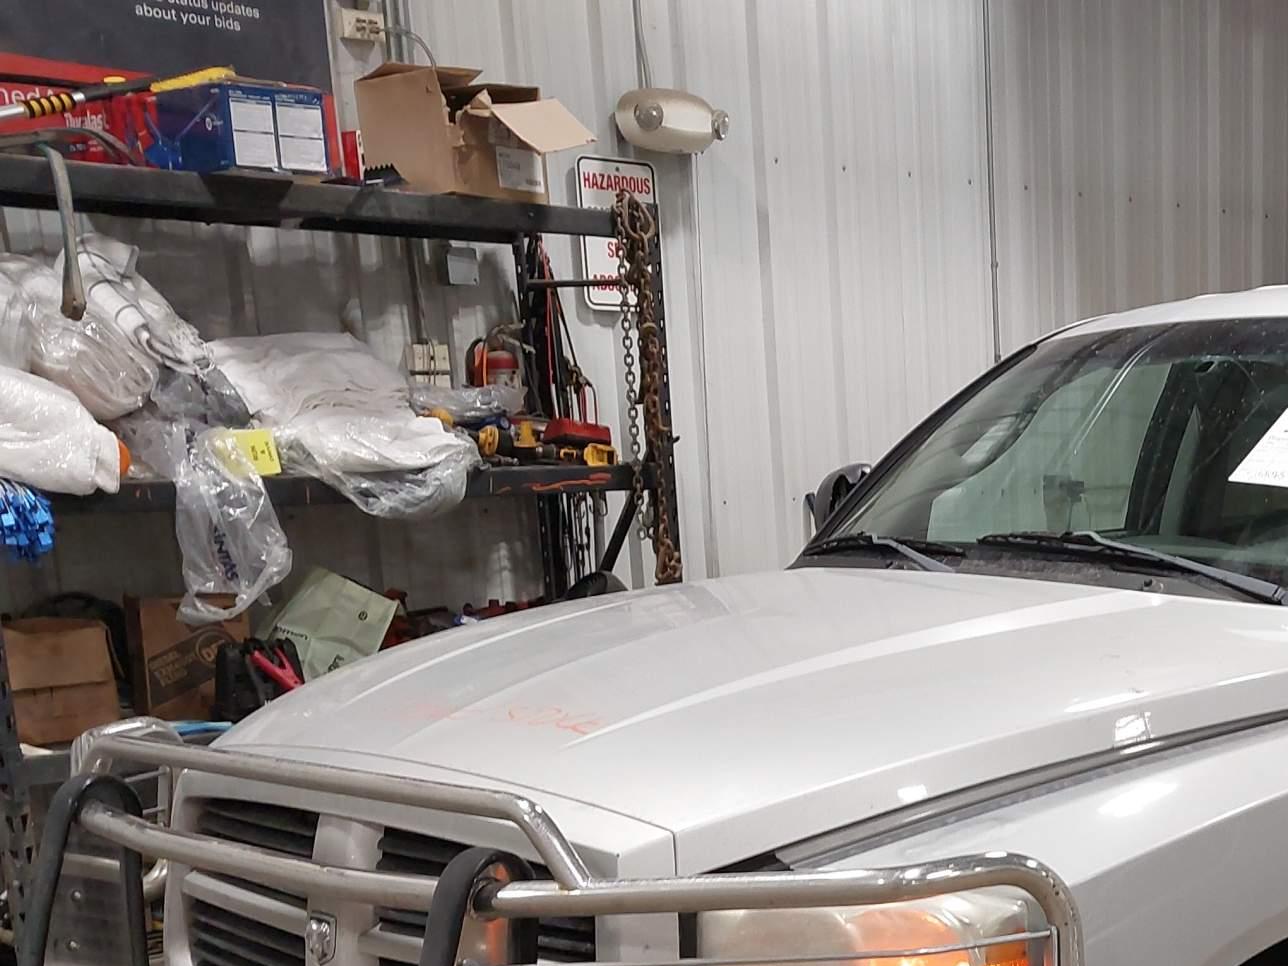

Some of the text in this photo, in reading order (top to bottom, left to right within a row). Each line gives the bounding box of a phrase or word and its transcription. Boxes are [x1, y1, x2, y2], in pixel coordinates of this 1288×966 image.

[135, 4, 241, 31] about your bids
[211, 1, 260, 19] updates
[583, 171, 651, 195] HAZARDOUS
